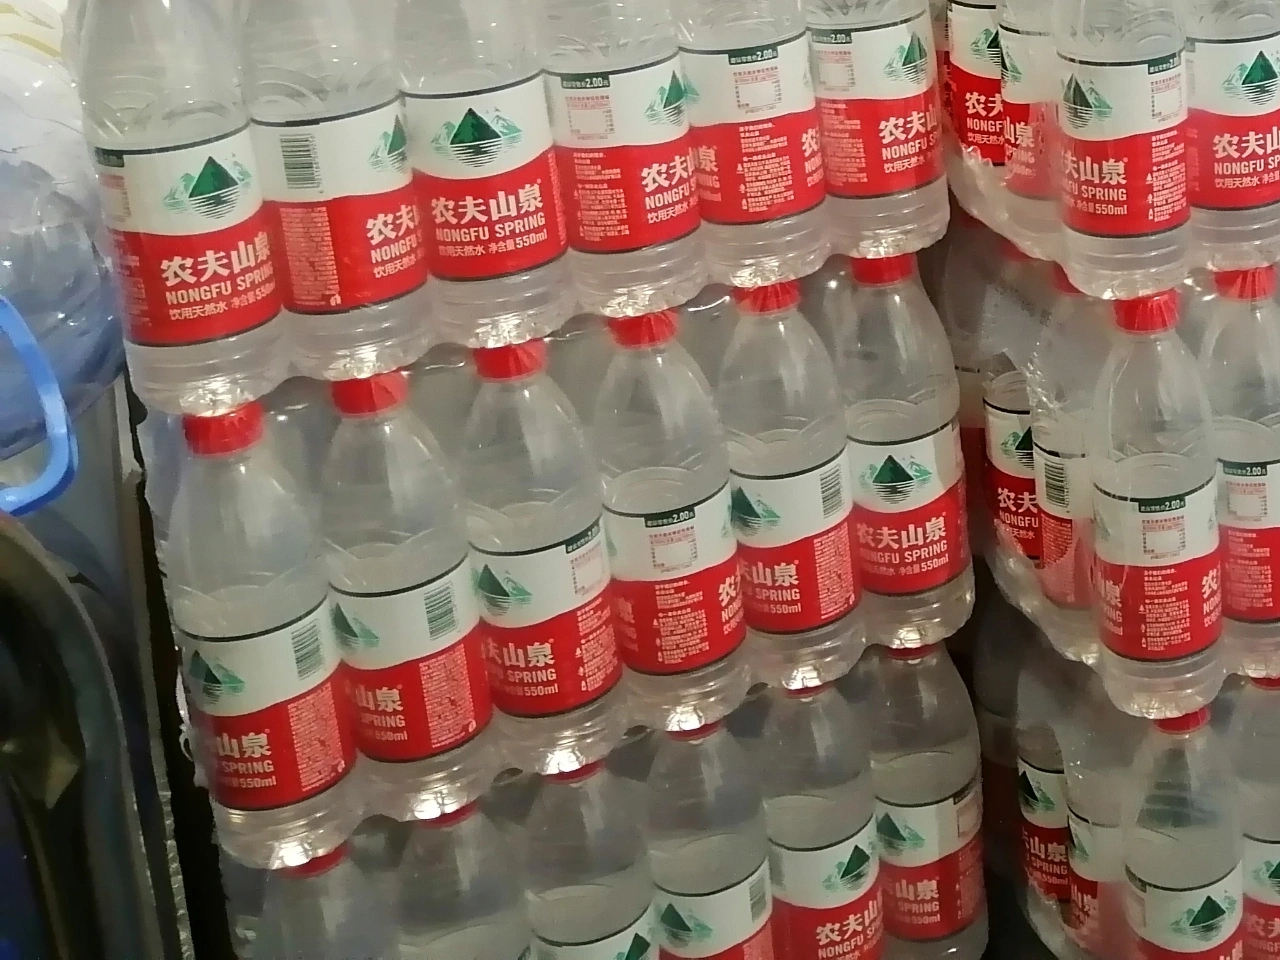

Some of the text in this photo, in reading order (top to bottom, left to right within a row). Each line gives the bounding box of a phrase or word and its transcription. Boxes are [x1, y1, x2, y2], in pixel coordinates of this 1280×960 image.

[882, 140, 927, 160] NONGFU
[1214, 157, 1264, 175] NONGFU
[1215, 173, 1260, 189] 饮用天然水
[431, 182, 544, 224] 农夫山泉
[645, 186, 689, 210] NONGFU
[1081, 184, 1127, 202] SPRING
[435, 212, 545, 241] NONGFU SPRING
[371, 236, 417, 264] NONGFU
[488, 229, 548, 254] 净含量550ml
[161, 230, 271, 286] 农夫山泉
[165, 262, 274, 305] NONGFU SPRING
[169, 301, 228, 320] 饮用天然水
[998, 488, 1038, 514] 农夫
[1001, 512, 1038, 529] NONGFU
[857, 515, 946, 550] 农夫山泉
[905, 540, 947, 563] SPRING
[755, 586, 799, 602] SPRING
[508, 667, 556, 682] SPRING
[361, 714, 405, 728] SPRING
[222, 759, 273, 774] SPRING
[1032, 856, 1068, 876] SPRING
[899, 900, 939, 913] SPRING
[818, 934, 863, 959] NONGFU
